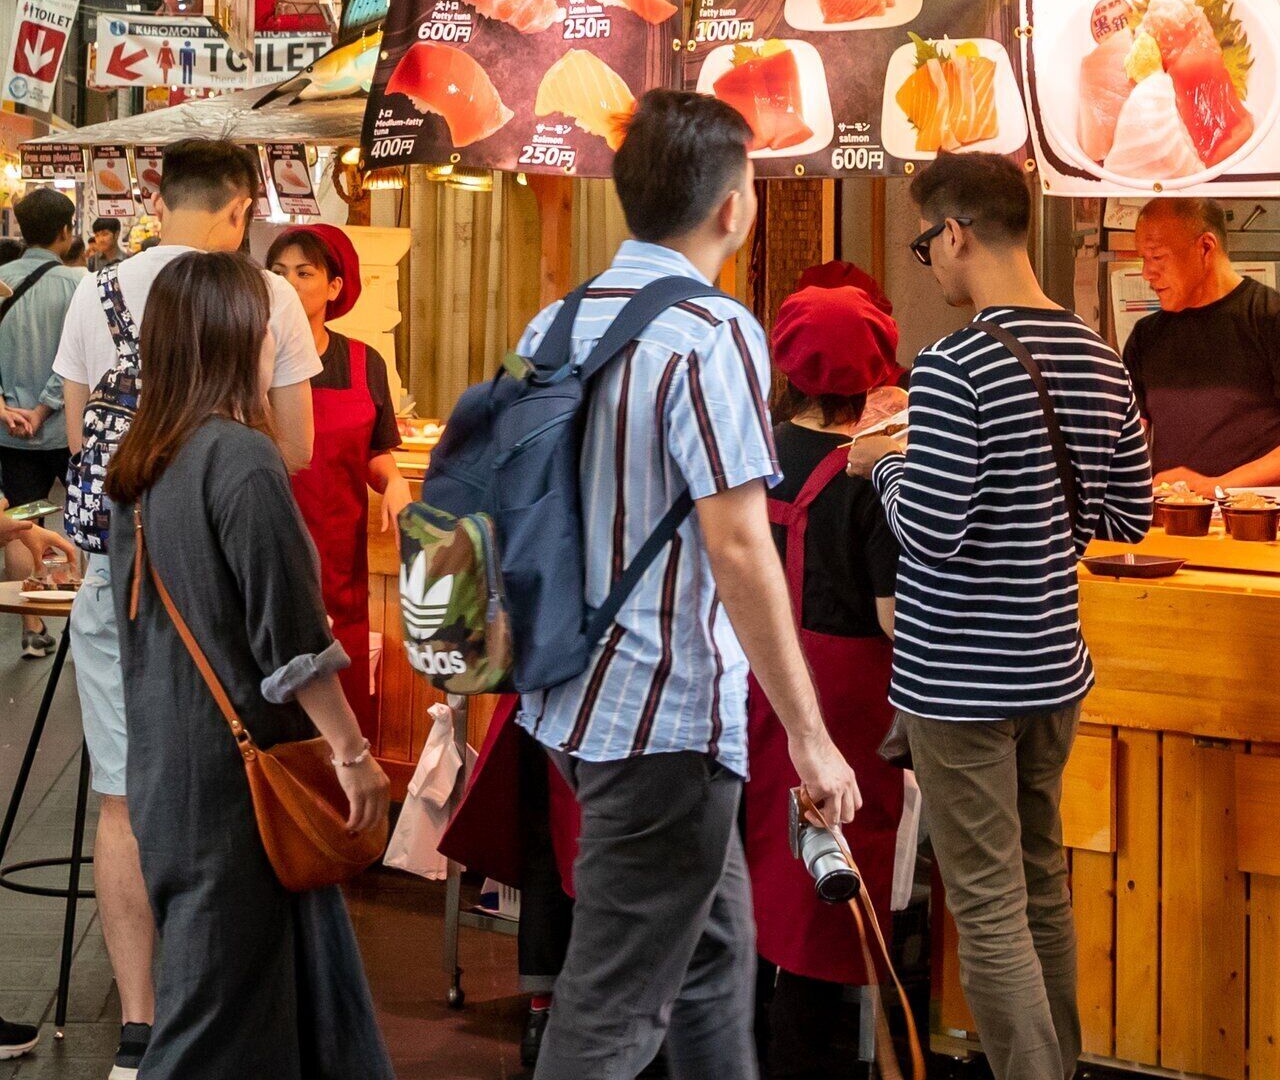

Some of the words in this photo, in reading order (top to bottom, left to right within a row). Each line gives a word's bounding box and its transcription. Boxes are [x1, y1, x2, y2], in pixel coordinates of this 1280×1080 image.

[35, 7, 72, 28] TOILET
[432, 11, 454, 21] Fatty
[454, 12, 472, 20] tuna
[699, 8, 718, 18] fatty
[719, 7, 737, 16] tuna
[135, 26, 200, 38] KUROMON
[418, 22, 472, 42] 600円
[563, 17, 611, 39] 250円
[695, 20, 754, 42] 1000円
[375, 117, 424, 128] Medium-fatty
[838, 122, 871, 132] サーモン
[374, 128, 389, 136] tuna
[535, 123, 572, 135] サーモン
[532, 134, 564, 145] Salmon
[839, 133, 870, 143] salmon
[371, 138, 414, 159] 400円
[519, 145, 576, 168] 250円
[831, 148, 884, 170] 600円
